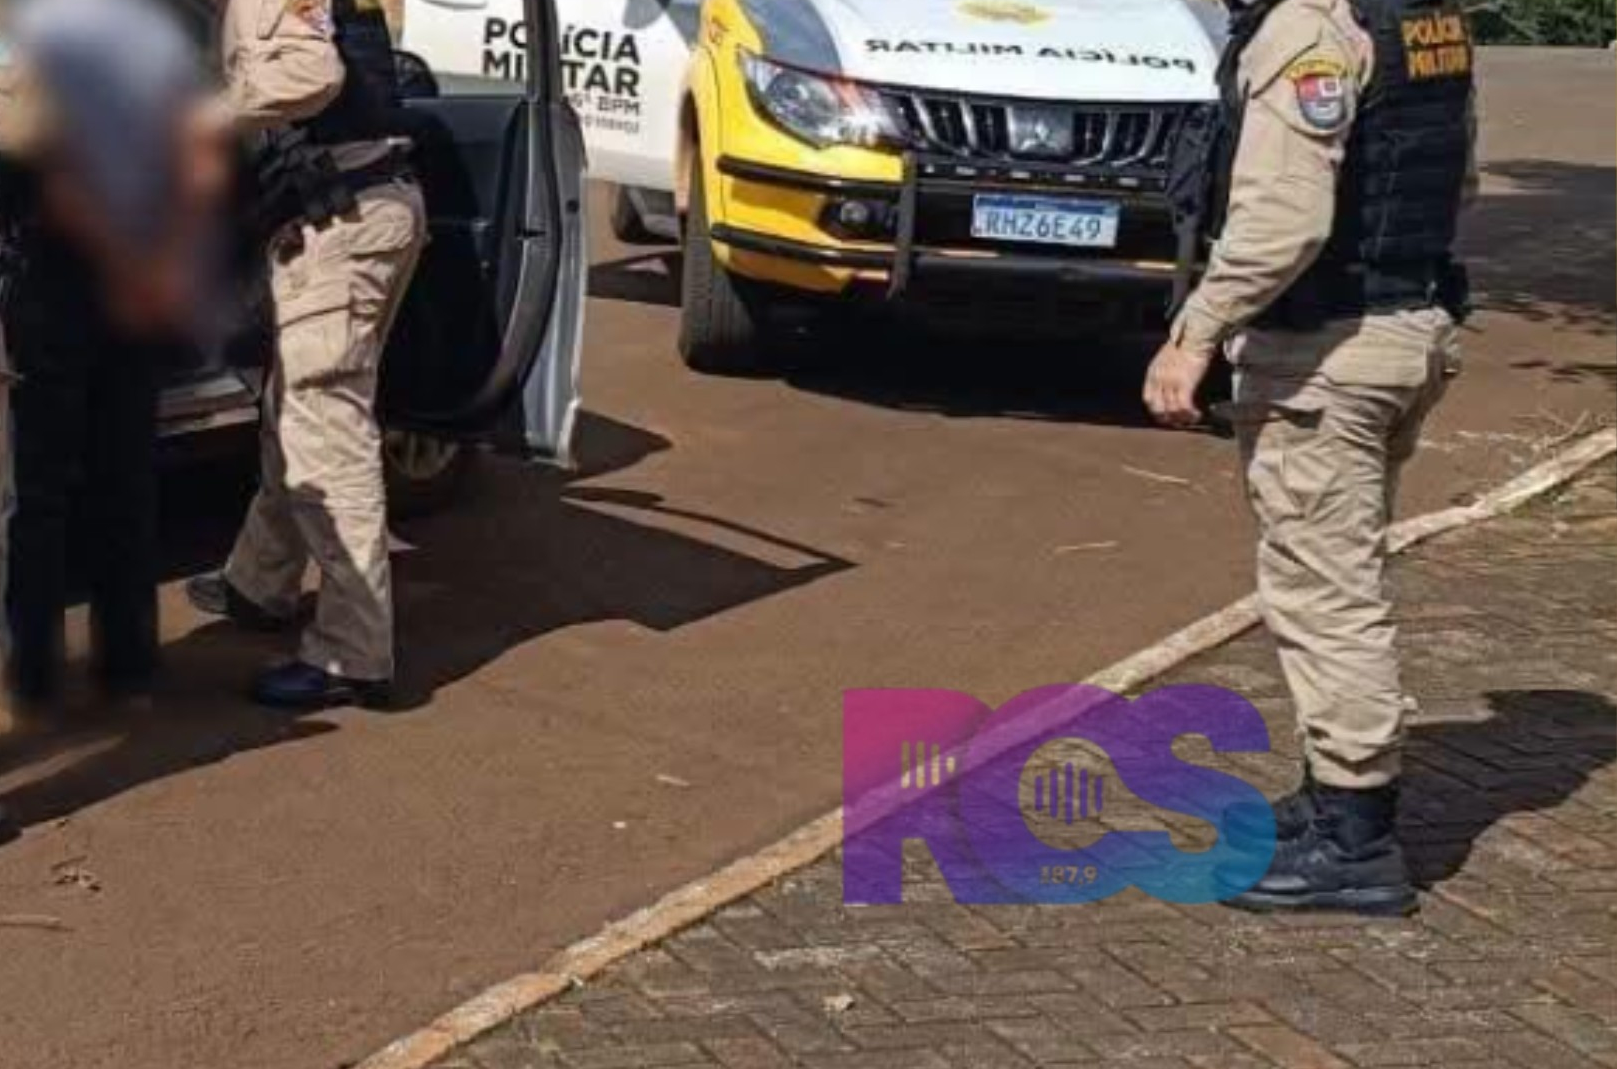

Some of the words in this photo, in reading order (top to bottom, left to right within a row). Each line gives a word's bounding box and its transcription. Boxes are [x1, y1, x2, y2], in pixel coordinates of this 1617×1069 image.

[484, 17, 640, 65] POÍCIA
[483, 48, 639, 97] MITAR
[986, 209, 1101, 241] RHZ6E49
